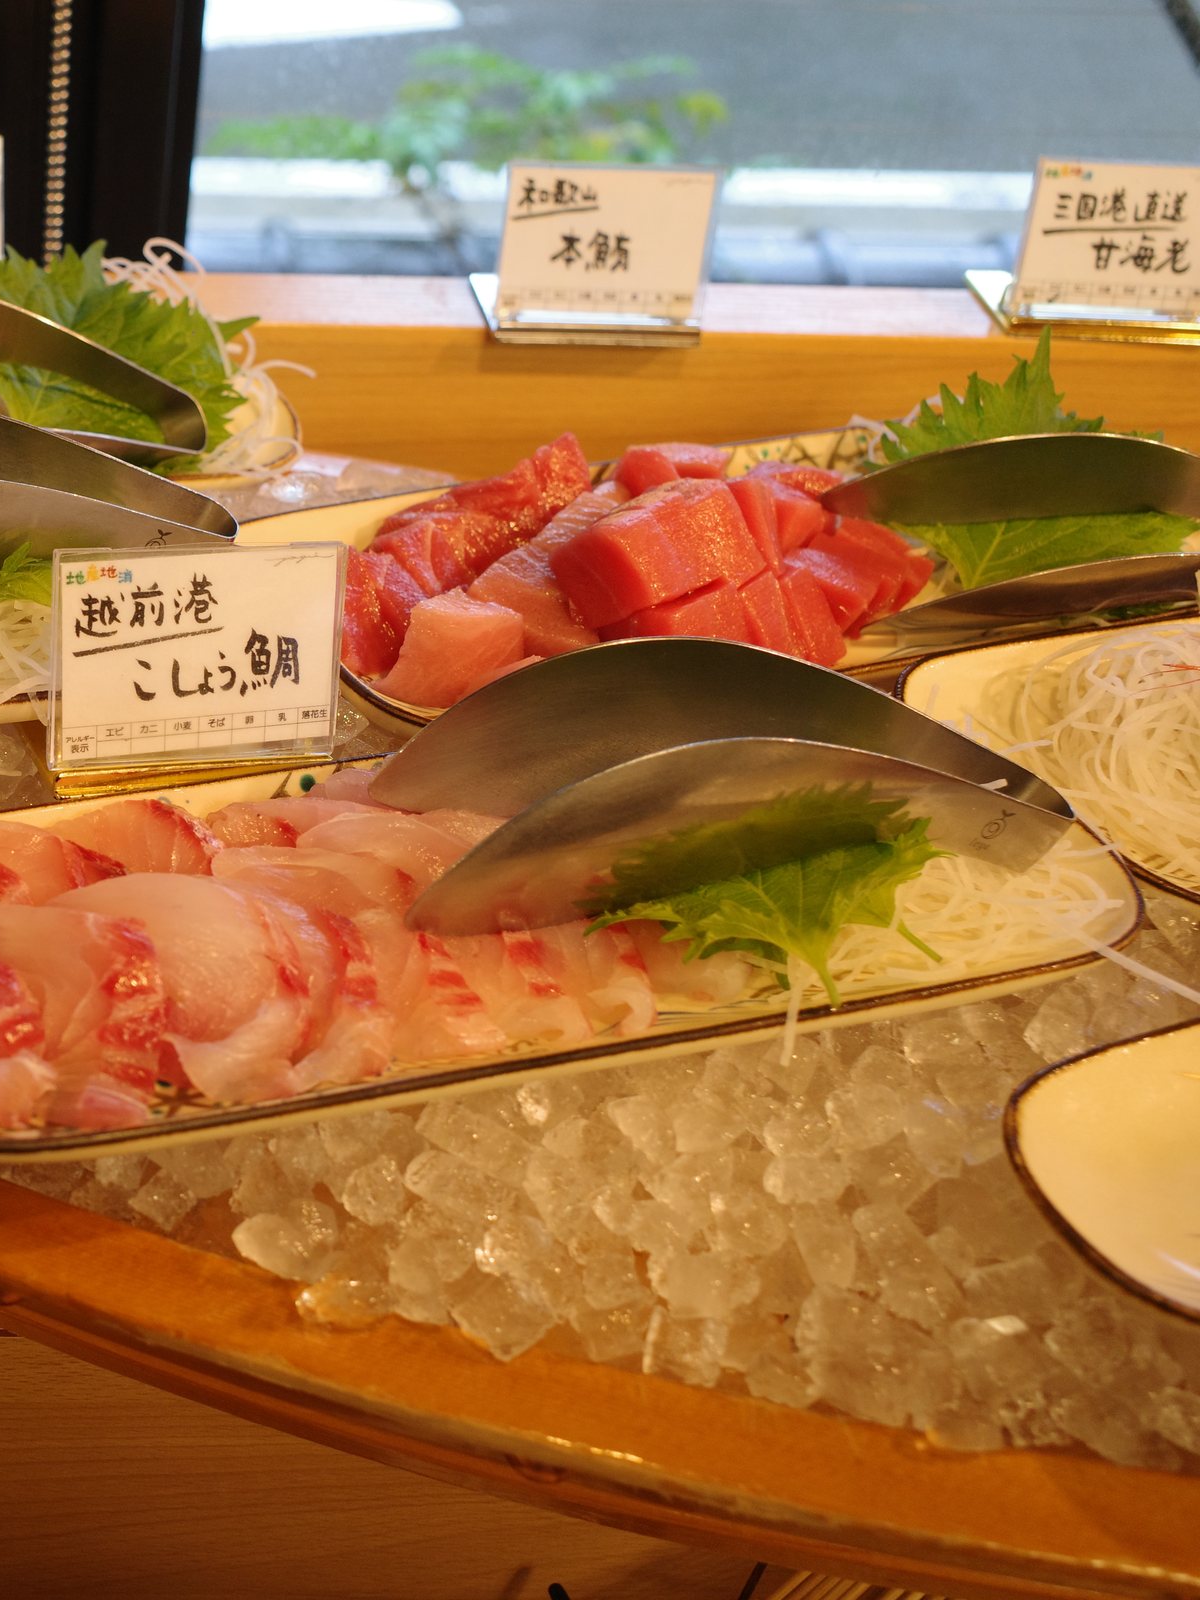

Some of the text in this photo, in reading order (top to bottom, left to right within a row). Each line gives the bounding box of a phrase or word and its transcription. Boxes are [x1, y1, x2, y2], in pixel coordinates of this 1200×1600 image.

[518, 178, 598, 212] 和歌山
[1053, 187, 1189, 222] 三国港直送
[551, 228, 630, 271] 本鮪
[1091, 235, 1191, 274] 甘海老
[74, 572, 219, 638] 越前港
[132, 627, 300, 701] こしょう鯛
[65, 735, 96, 743] アレルギー
[105, 726, 125, 737] エビ
[139, 724, 158, 734] カニ
[173, 720, 192, 731] 小麦
[207, 717, 226, 728] そば
[301, 709, 328, 720] 落花生
[70, 743, 89, 754] 表示
